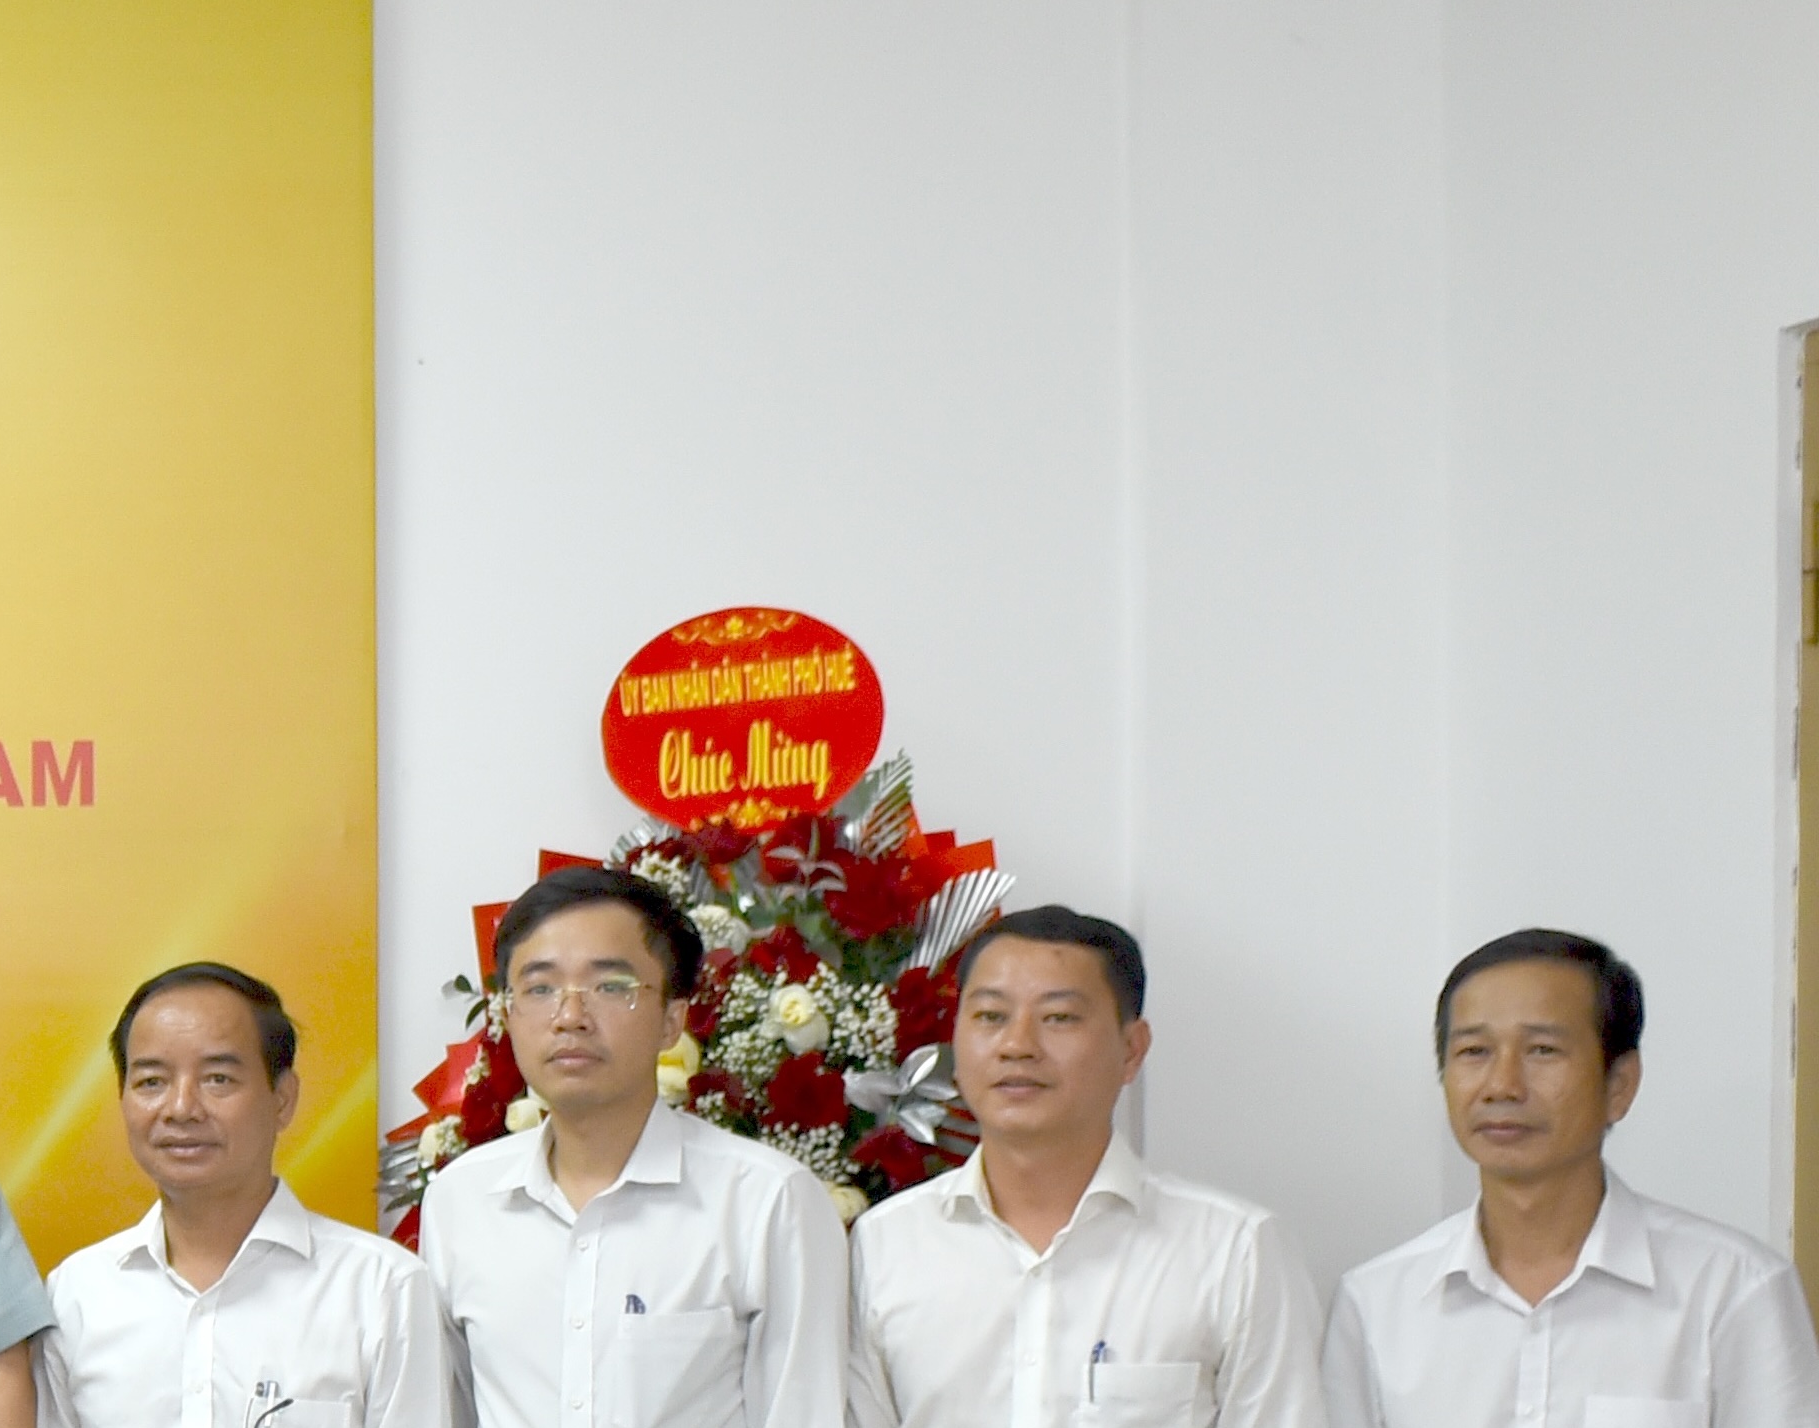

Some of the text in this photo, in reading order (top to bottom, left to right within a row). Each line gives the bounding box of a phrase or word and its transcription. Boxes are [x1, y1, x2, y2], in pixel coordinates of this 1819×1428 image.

[641, 676, 670, 714] BAN
[671, 659, 710, 711] NHÂN
[712, 655, 742, 706] DÂN
[659, 718, 831, 801] Chúc Mừng
